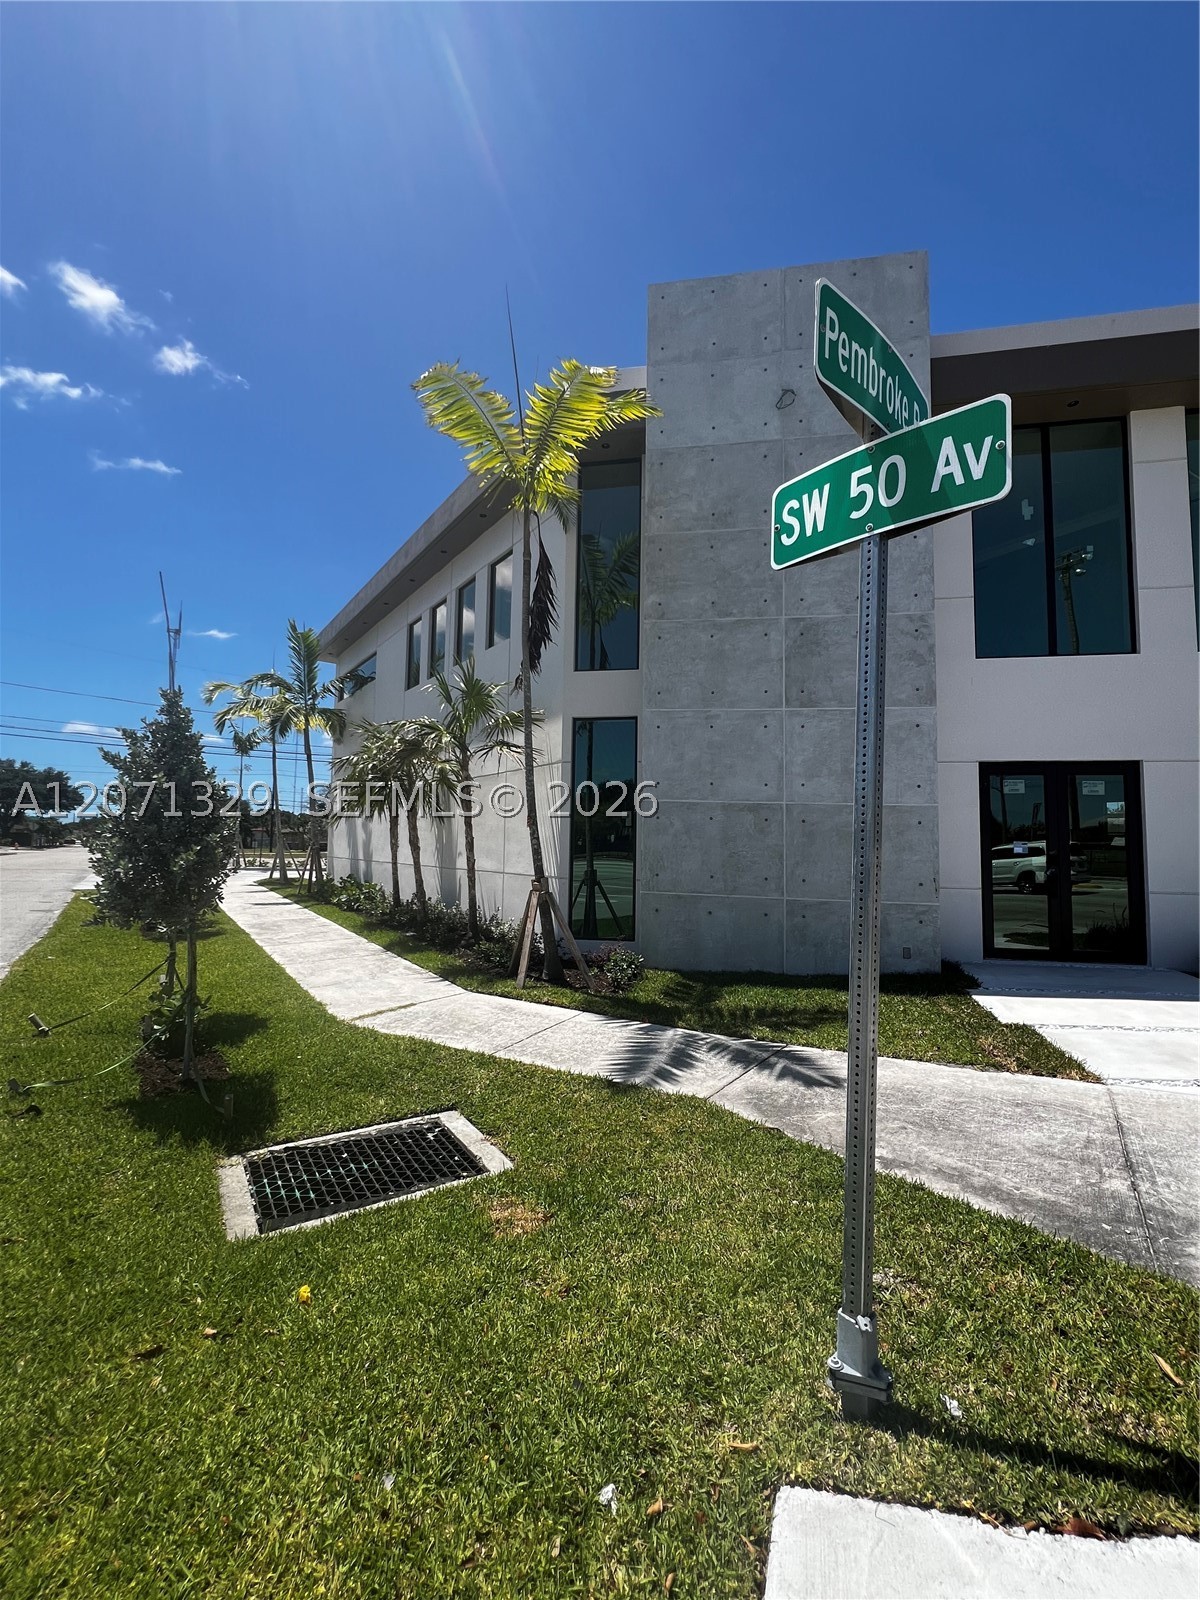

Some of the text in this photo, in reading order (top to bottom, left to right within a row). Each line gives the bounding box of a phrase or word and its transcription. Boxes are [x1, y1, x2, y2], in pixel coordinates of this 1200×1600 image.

[824, 306, 909, 429] Pembroke
[780, 435, 994, 546] SW 50 Av
